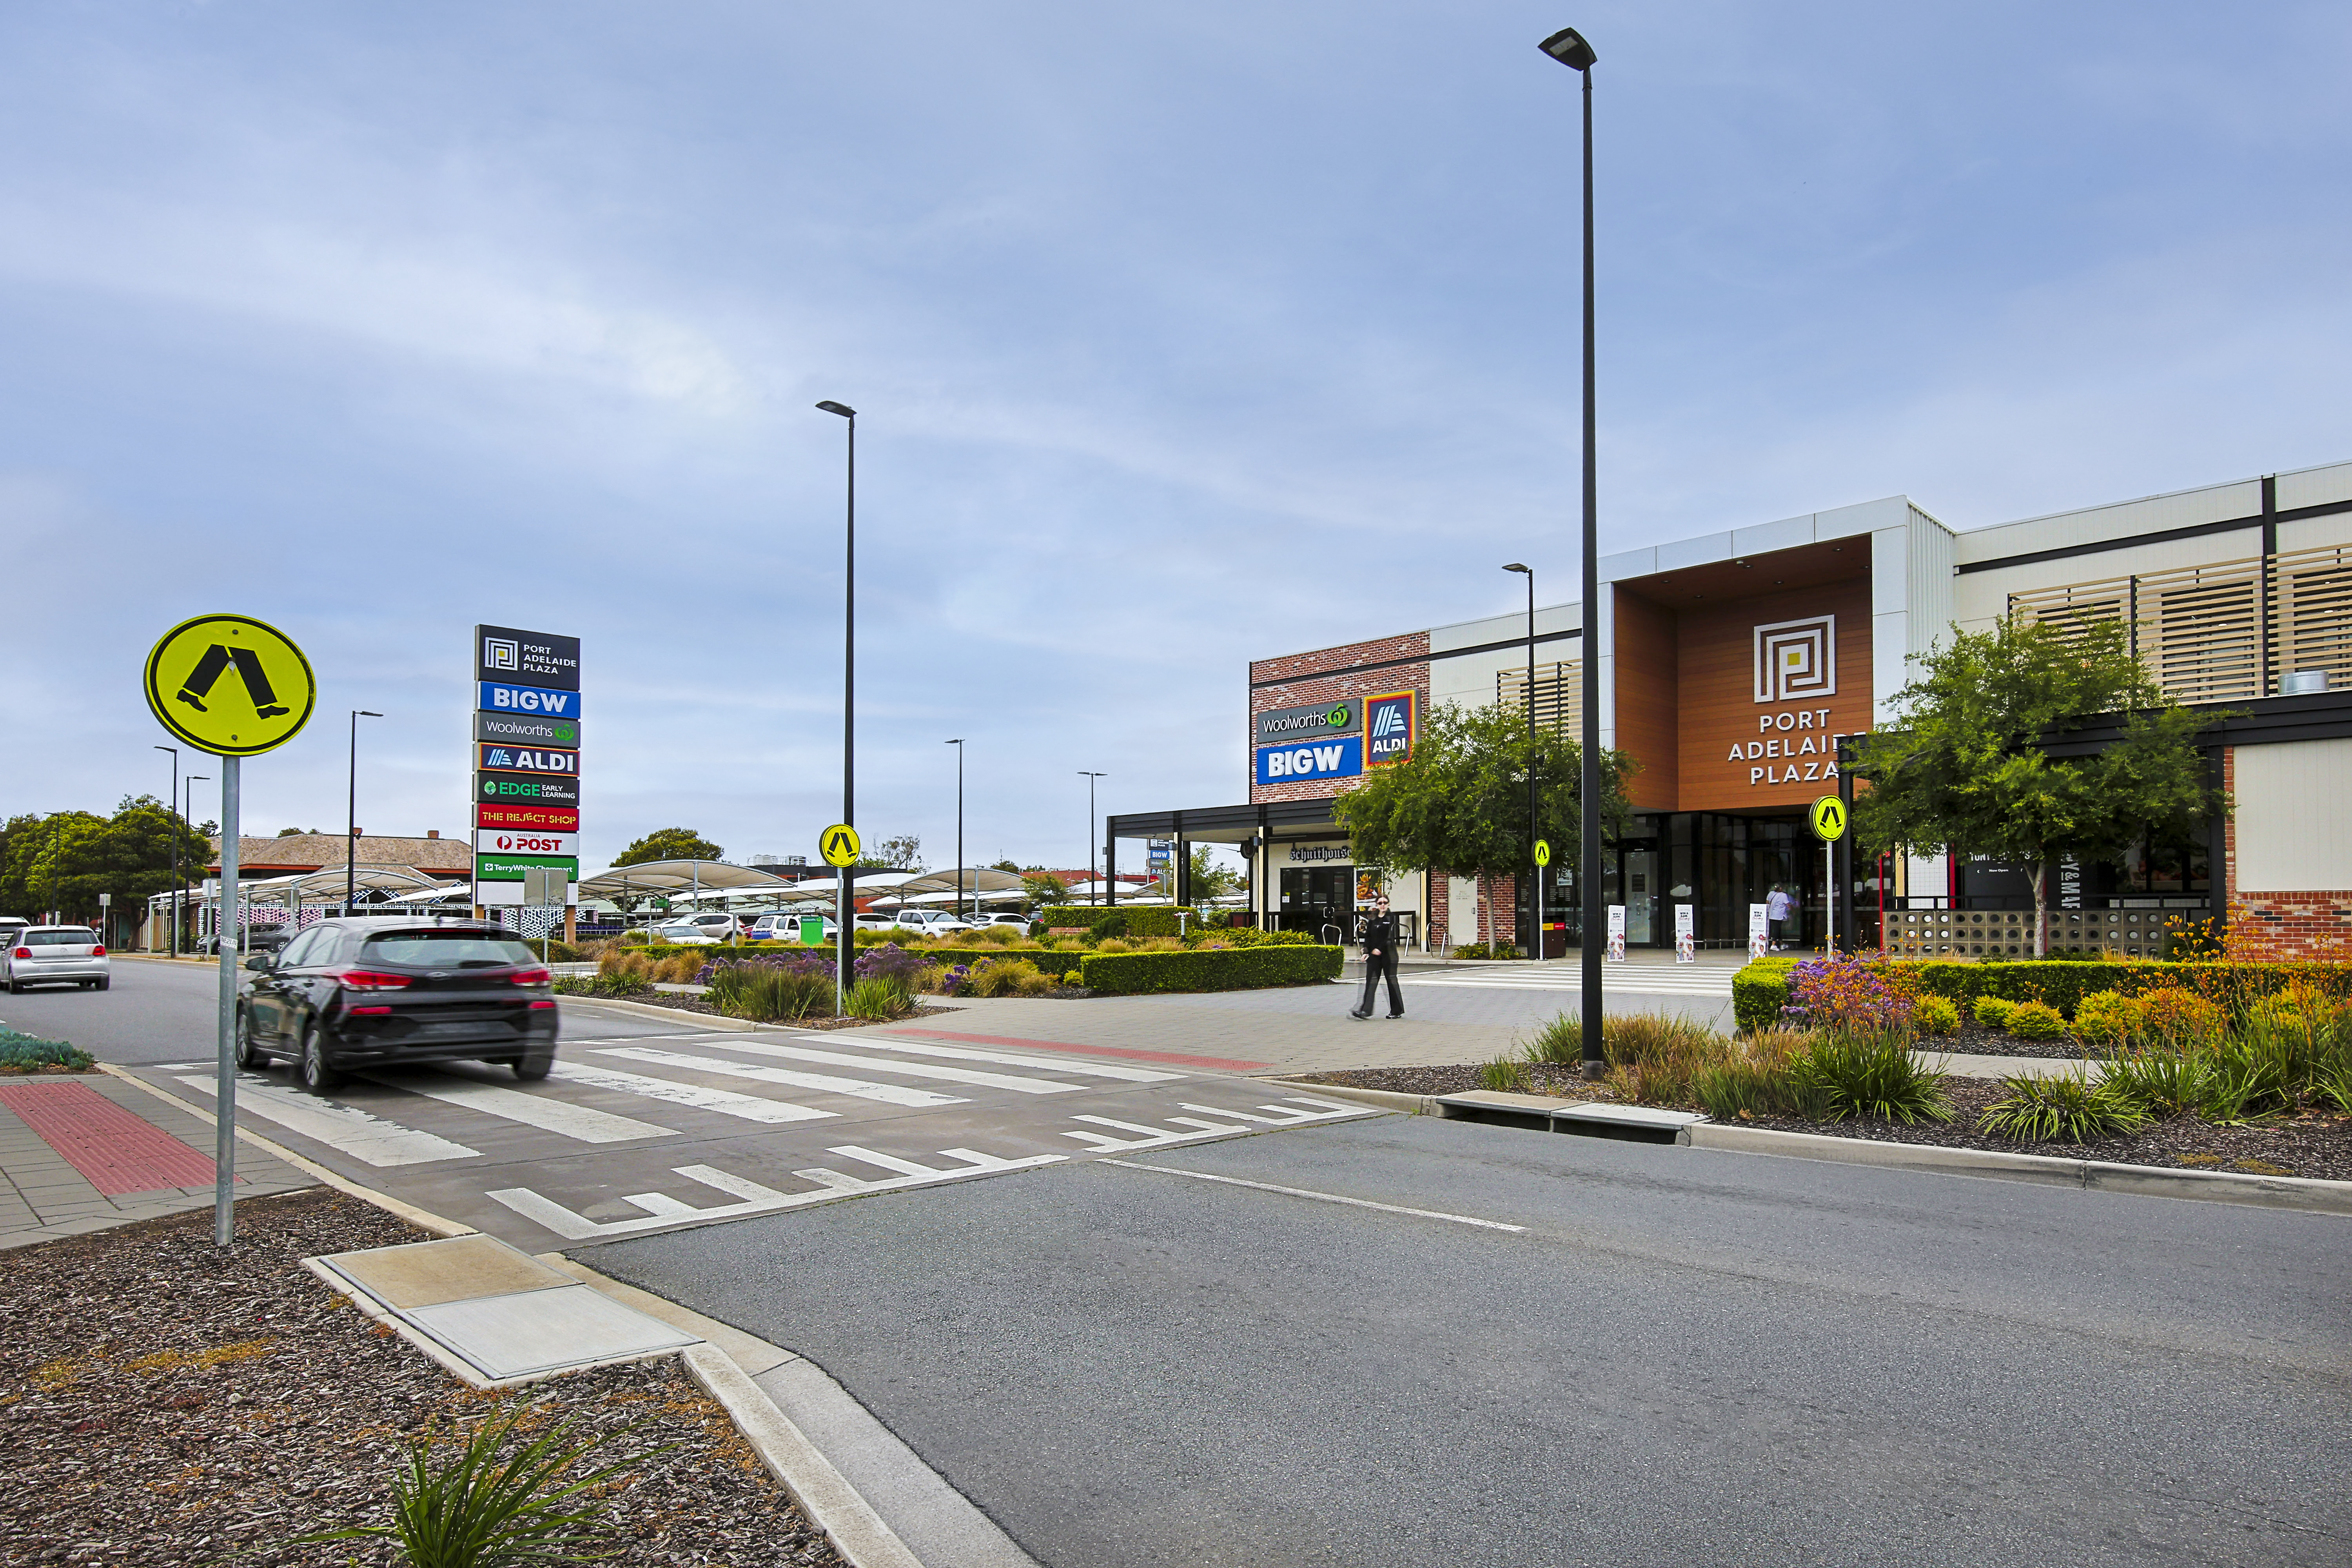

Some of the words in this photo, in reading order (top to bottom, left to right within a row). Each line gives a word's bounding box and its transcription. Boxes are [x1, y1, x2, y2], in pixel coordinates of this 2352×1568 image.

[523, 644, 551, 654] PORT
[524, 654, 577, 667] ADELAIDE
[523, 663, 558, 674] PLAZA
[1263, 711, 1326, 733] Woolworths
[1760, 709, 1829, 733] PORT
[486, 721, 552, 737] Woolworths
[1372, 737, 1406, 753] ALDI
[1728, 731, 1866, 761] ADELAI
[516, 751, 573, 771] ALDI
[1751, 761, 1839, 785] PLAZA
[499, 782, 540, 796] EDGE
[483, 812, 503, 820] THE
[506, 813, 546, 822] REJECT
[549, 815, 576, 824] SHOP
[517, 838, 562, 851] POST
[494, 864, 535, 873] TerryWhite
